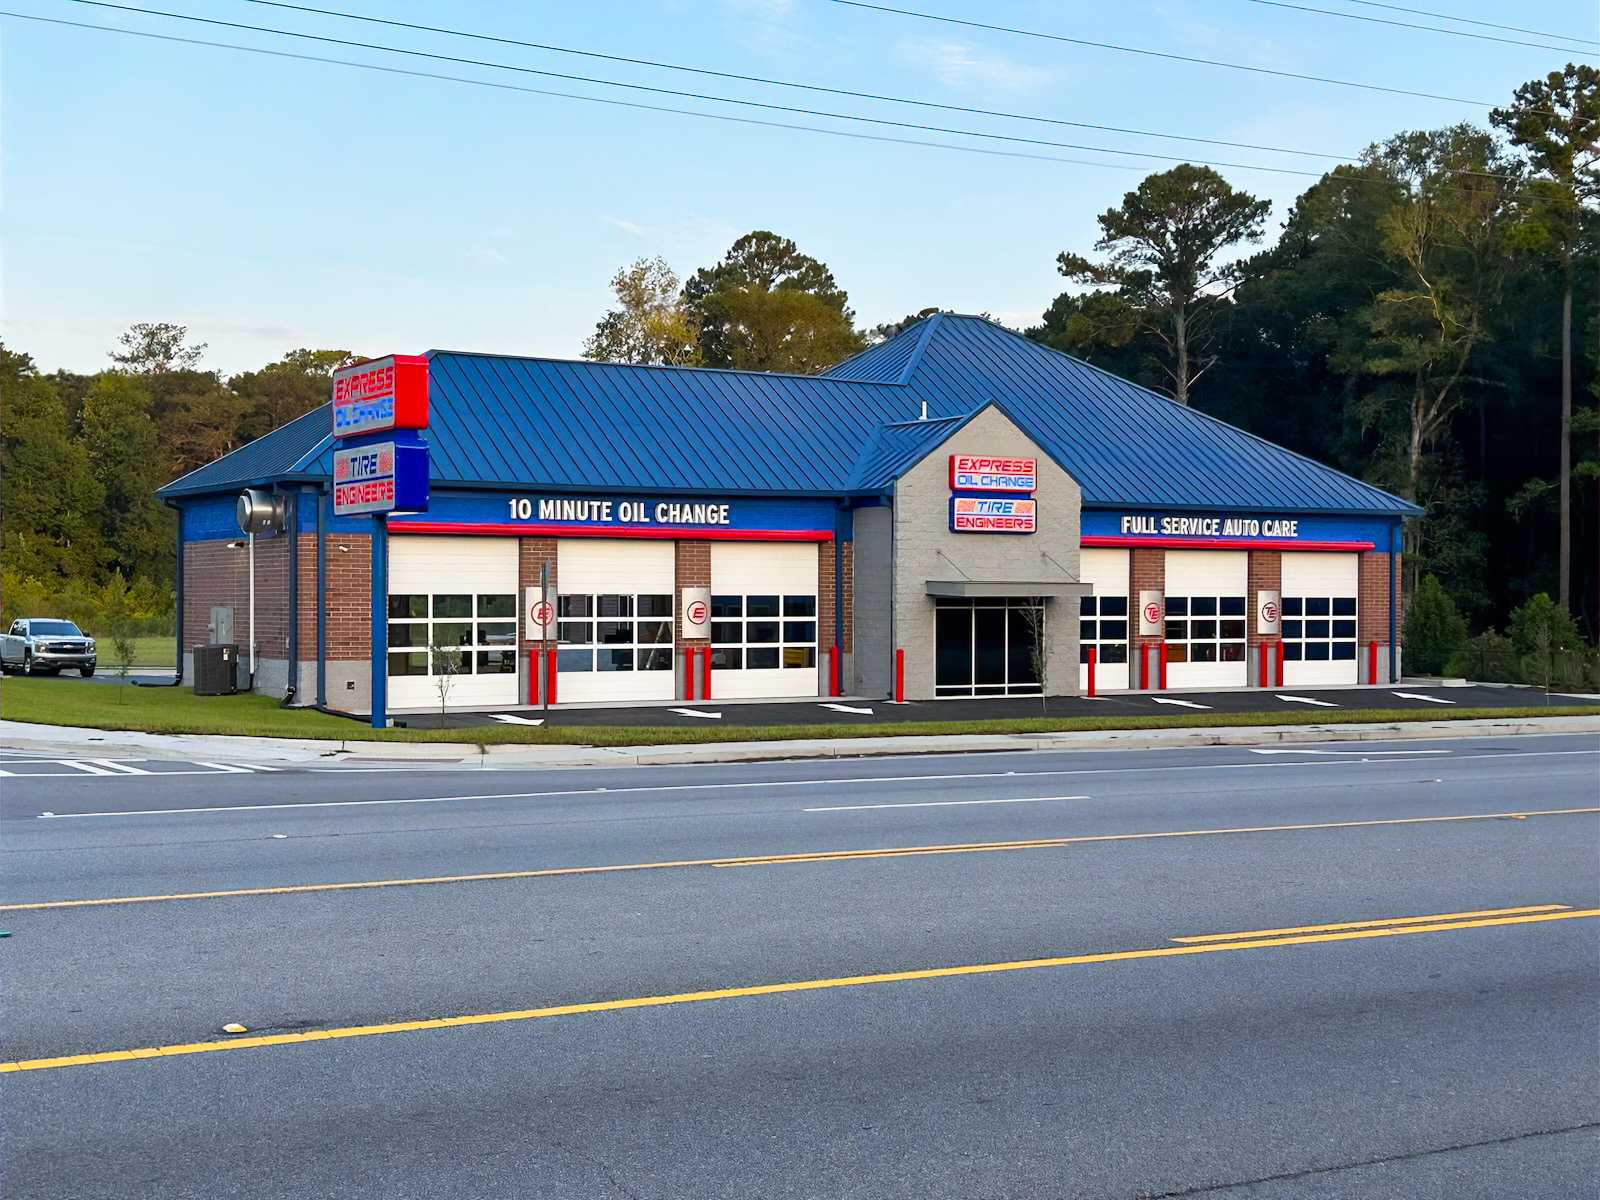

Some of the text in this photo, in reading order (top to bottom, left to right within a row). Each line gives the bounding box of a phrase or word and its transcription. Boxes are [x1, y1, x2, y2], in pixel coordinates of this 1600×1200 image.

[335, 367, 393, 400] EXPRESS
[350, 453, 378, 477] TIRE
[958, 458, 1034, 473] EXPRESS
[957, 475, 1034, 488] OIL CHANGE
[336, 481, 394, 506] ENGINEERS
[508, 499, 730, 525] 10 MINUTE OIL CHANGE
[977, 501, 1014, 514] TIRE
[956, 517, 1034, 529] ENGINEERS
[1121, 516, 1298, 537] FULL SERVICE AUTO CARE
[1146, 606, 1160, 621] TE
[1264, 606, 1278, 620] TE
